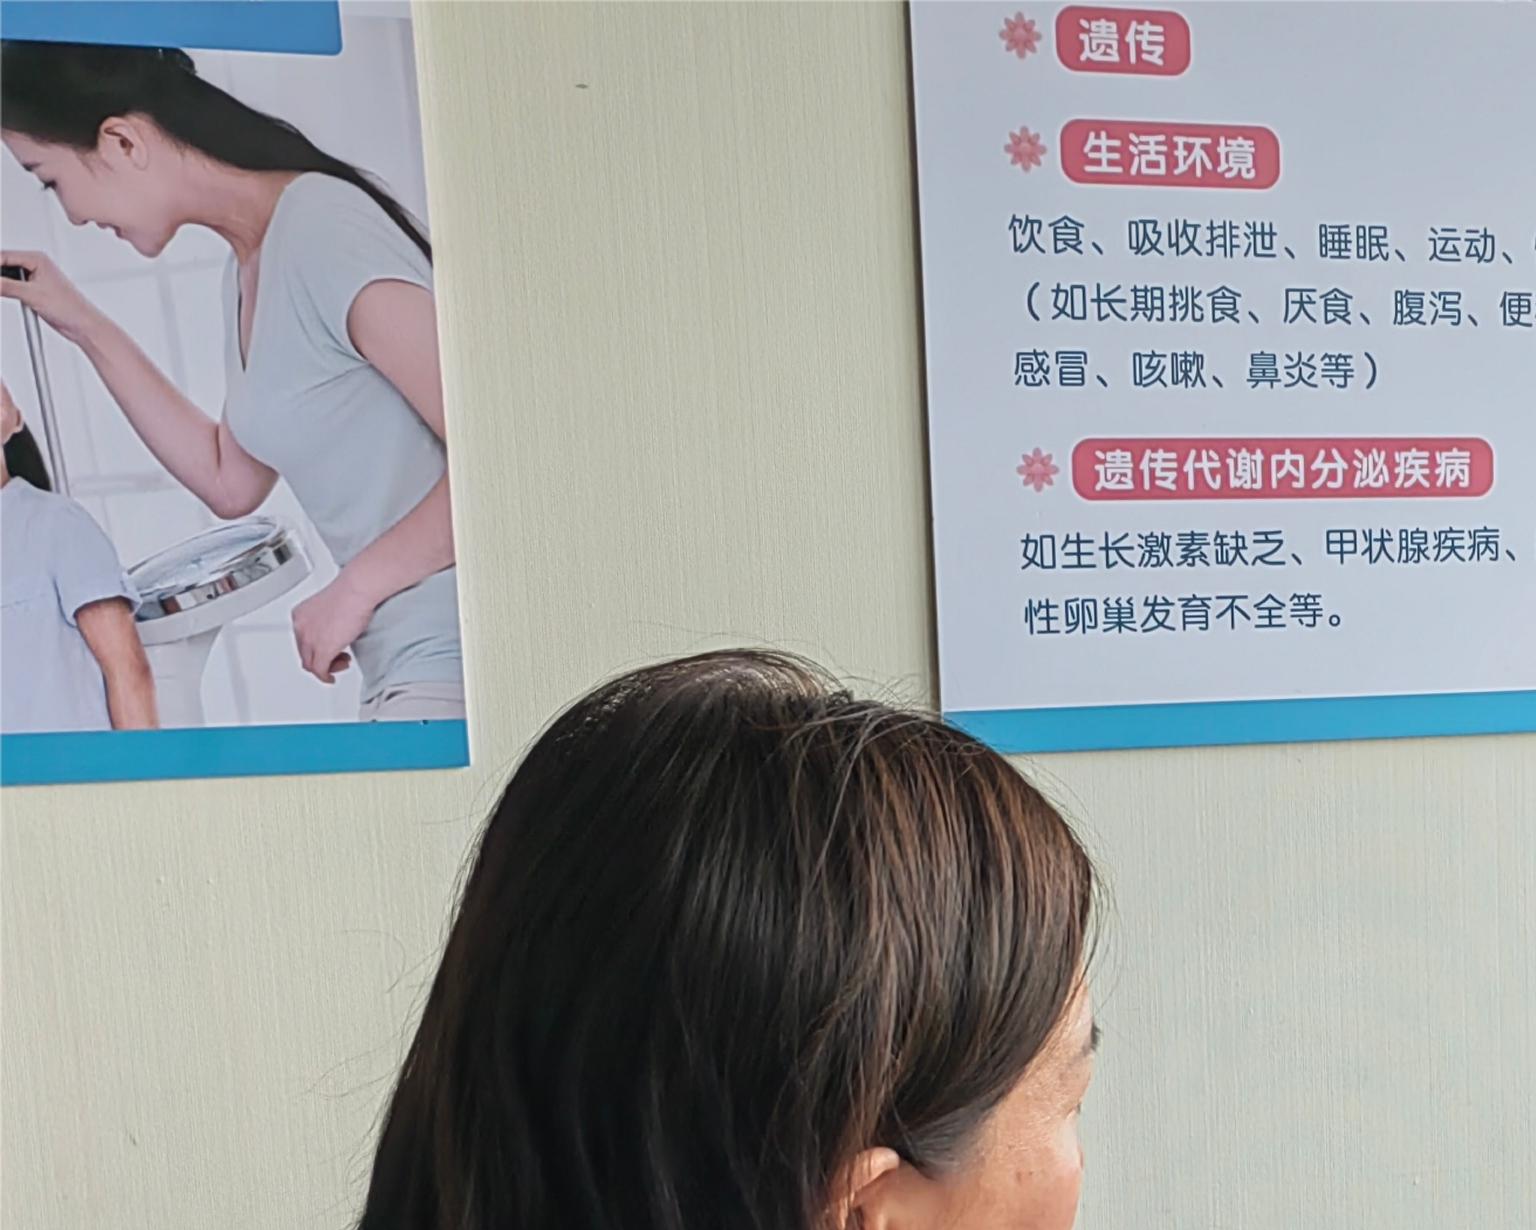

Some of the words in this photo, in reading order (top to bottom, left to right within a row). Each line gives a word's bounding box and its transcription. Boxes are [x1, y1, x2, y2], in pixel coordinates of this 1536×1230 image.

[1079, 18, 1166, 66] 遗传
[1083, 130, 1257, 180] 生活环境
[1093, 446, 1472, 492] 遗传代谢内分泌疾病
[1024, 592, 1343, 637] 性卵巢发育不全等。
